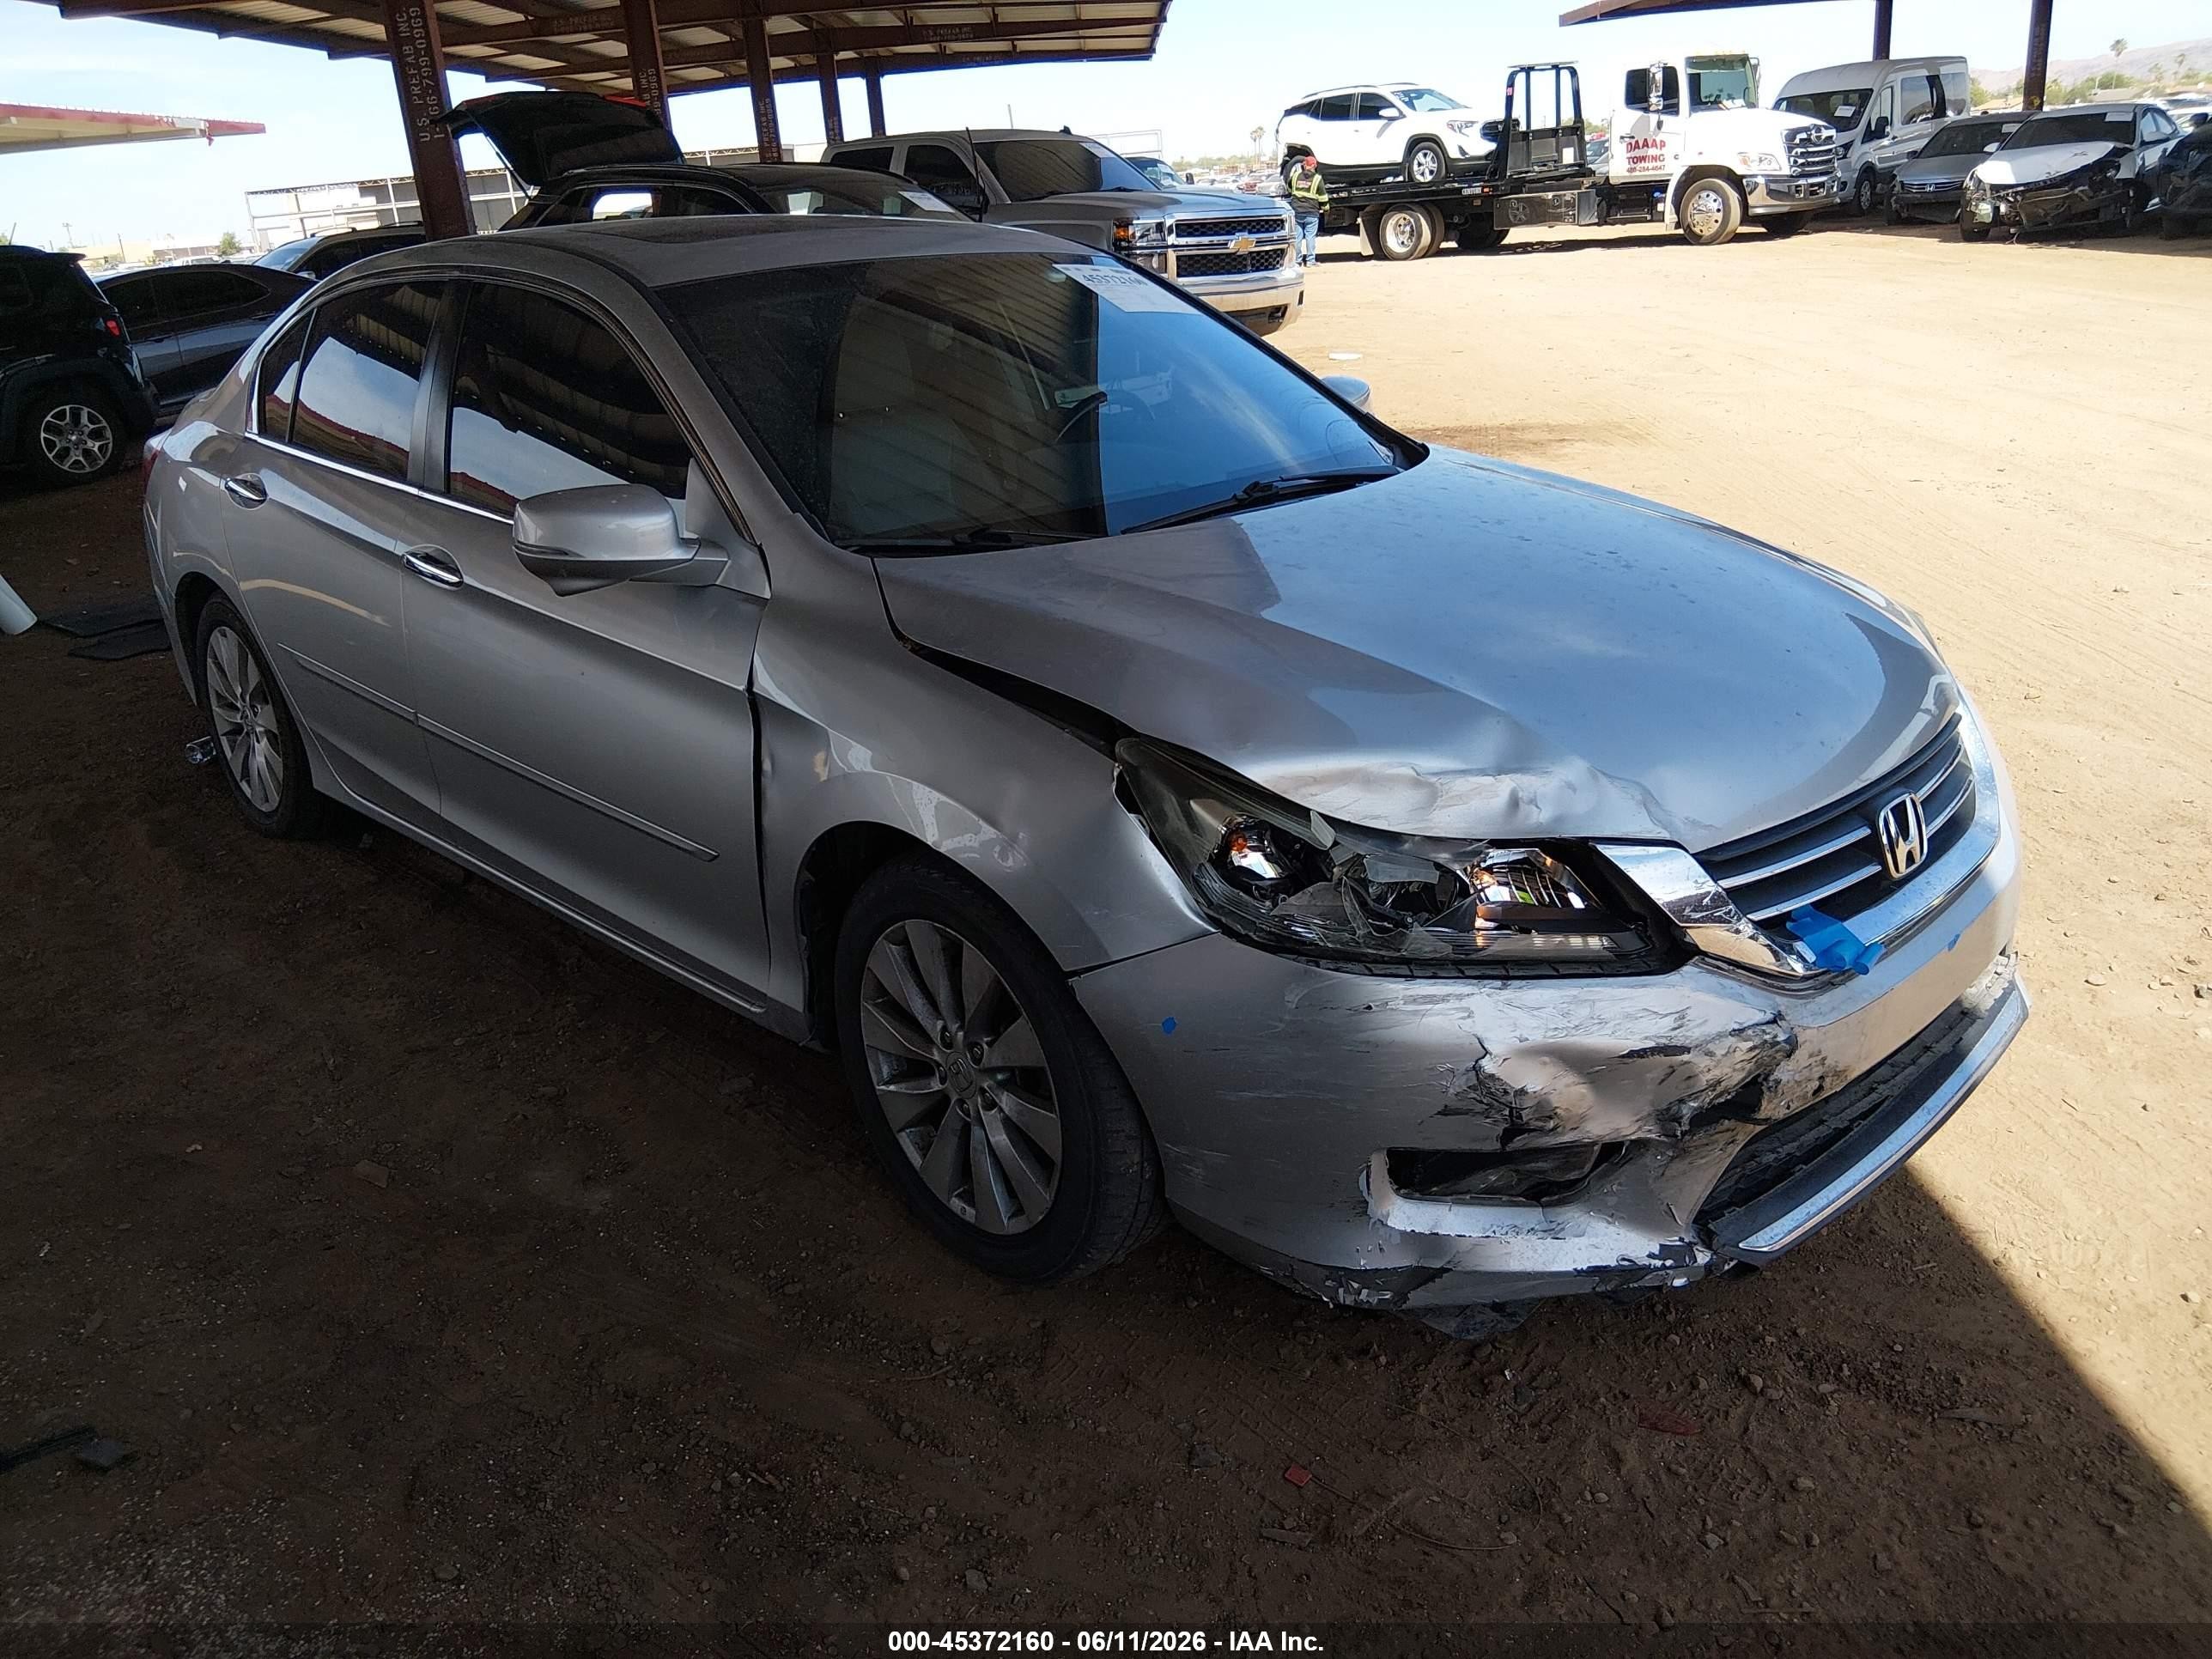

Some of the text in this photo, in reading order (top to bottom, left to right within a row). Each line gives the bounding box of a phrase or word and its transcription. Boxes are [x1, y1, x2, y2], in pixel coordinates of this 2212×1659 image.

[396, 7, 410, 37] INC.
[402, 45, 424, 104] PREFAB
[409, 7, 445, 138] 1-66-799-0969
[1626, 137, 1666, 154] DAAAP
[1626, 154, 1665, 165] TOWING
